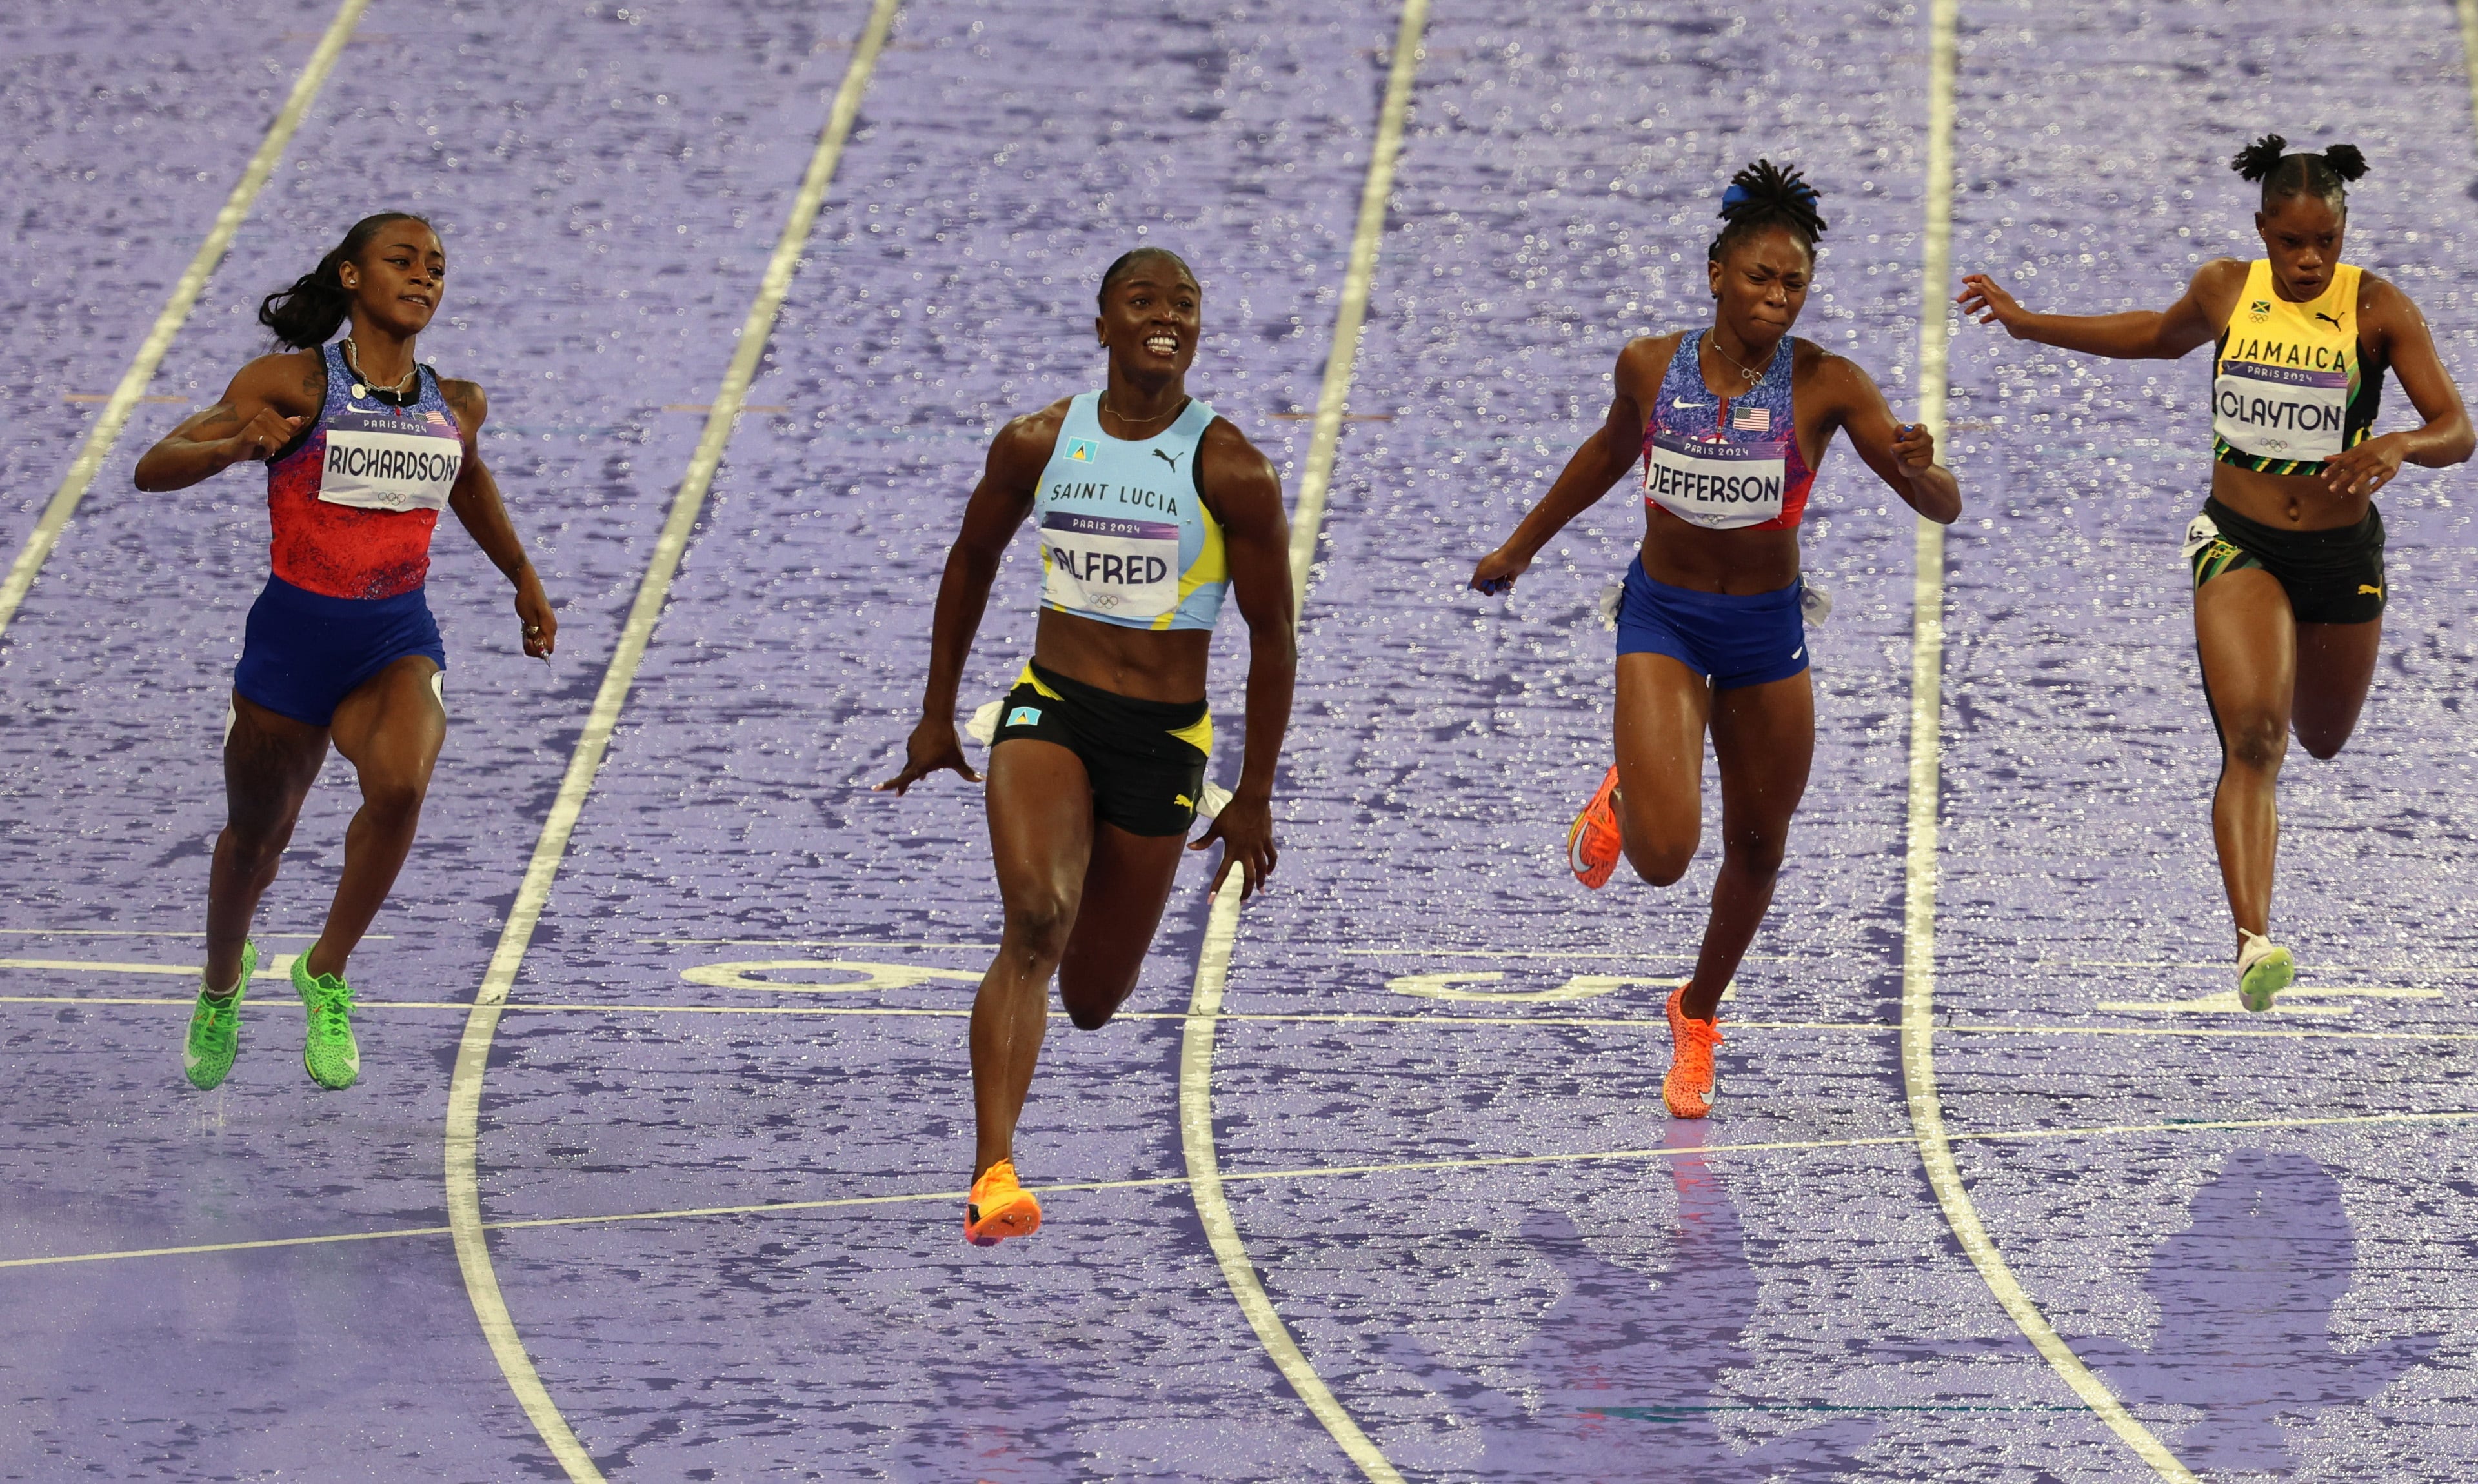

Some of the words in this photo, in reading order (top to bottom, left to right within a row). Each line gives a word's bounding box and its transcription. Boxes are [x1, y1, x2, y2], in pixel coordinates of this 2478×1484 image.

[2231, 339, 2346, 372] JAMAICA
[2247, 365, 2280, 378] PARIS
[2283, 372, 2313, 383] 2024
[363, 419, 397, 429] PARIS
[401, 422, 427, 433] 2024
[2220, 390, 2341, 432] CLAYTON
[328, 445, 458, 482] RICHARDSON
[1684, 442, 1714, 455] PARIS
[1718, 448, 1749, 456] 2024
[1051, 483, 1109, 501] SAINT
[1120, 486, 1178, 516] LUCIA
[1649, 463, 1780, 503] JEFFERSON
[1073, 518, 1106, 530] PARIS
[1110, 523, 1141, 534] 2024
[1053, 547, 1167, 585] ALFRED
